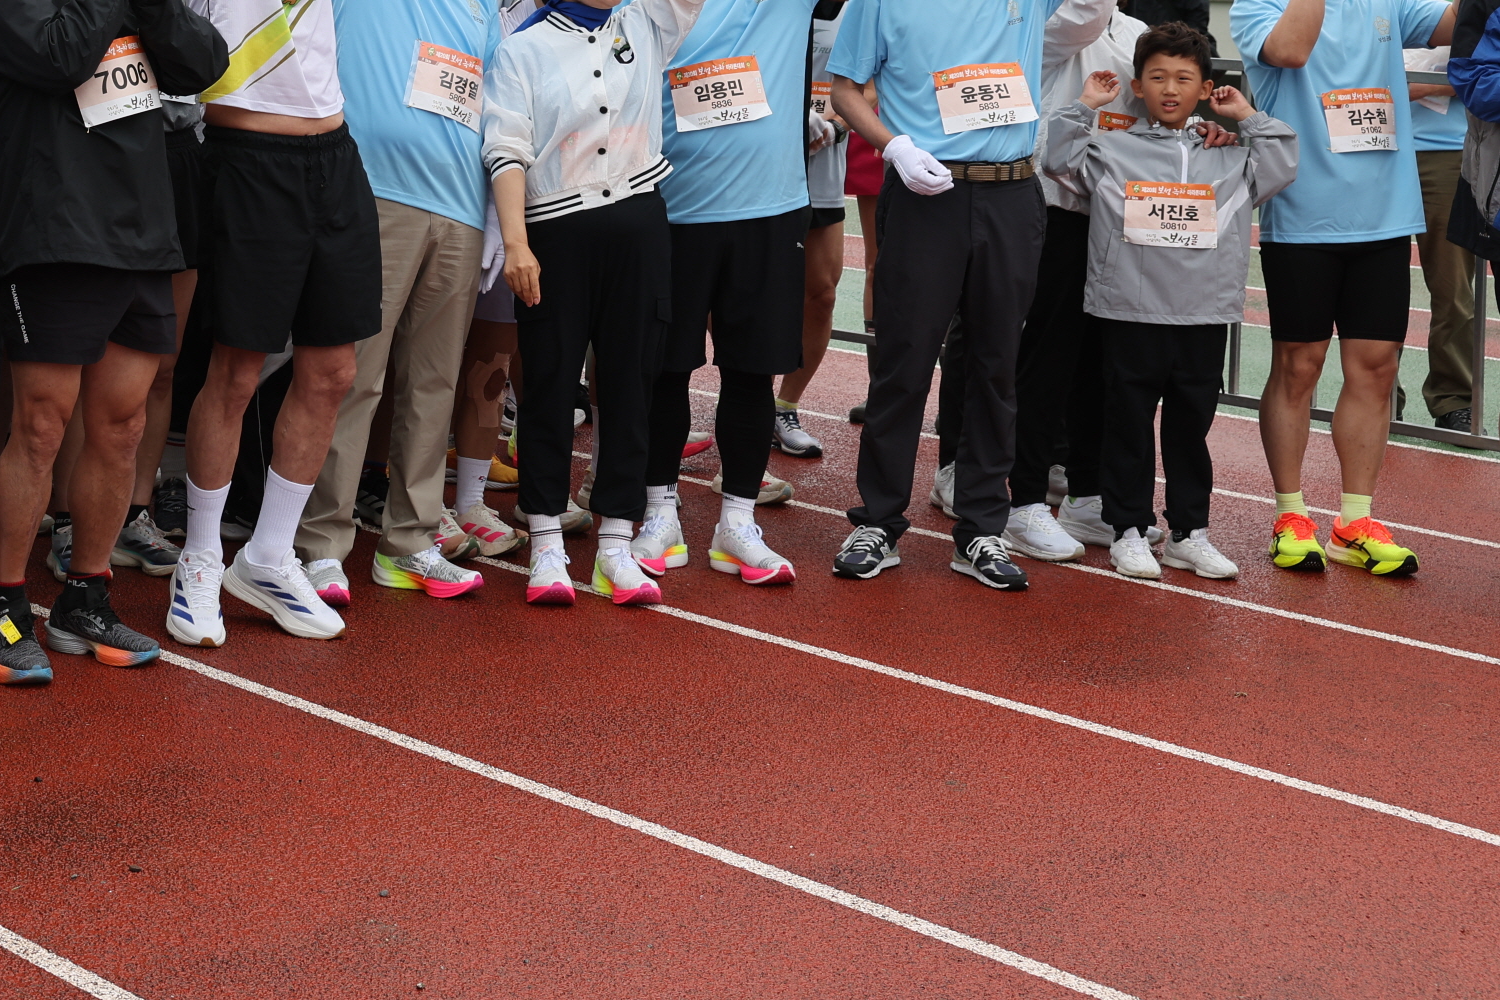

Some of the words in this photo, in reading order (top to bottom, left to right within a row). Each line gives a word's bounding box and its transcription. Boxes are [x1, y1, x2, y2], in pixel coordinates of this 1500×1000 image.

[94, 61, 148, 94] 7006
[694, 79, 744, 102] 임용민
[961, 83, 1011, 103] 윤동진
[131, 93, 154, 110] 보성몰
[449, 92, 466, 105] 5800
[711, 99, 733, 109] 5836
[979, 102, 999, 111] 5833
[451, 105, 473, 124] 보성몰
[720, 108, 750, 121] 보성몰
[988, 110, 1017, 123] 보성몰
[1348, 109, 1387, 126] 김수철
[1361, 126, 1382, 134] 51062
[1371, 136, 1390, 148] 보성몰
[1148, 204, 1199, 221] 서진호
[1160, 222, 1187, 230] 50810
[1169, 233, 1198, 246] 보성몰
[10, 283, 20, 311] CHANGE
[20, 324, 30, 344] GAME
